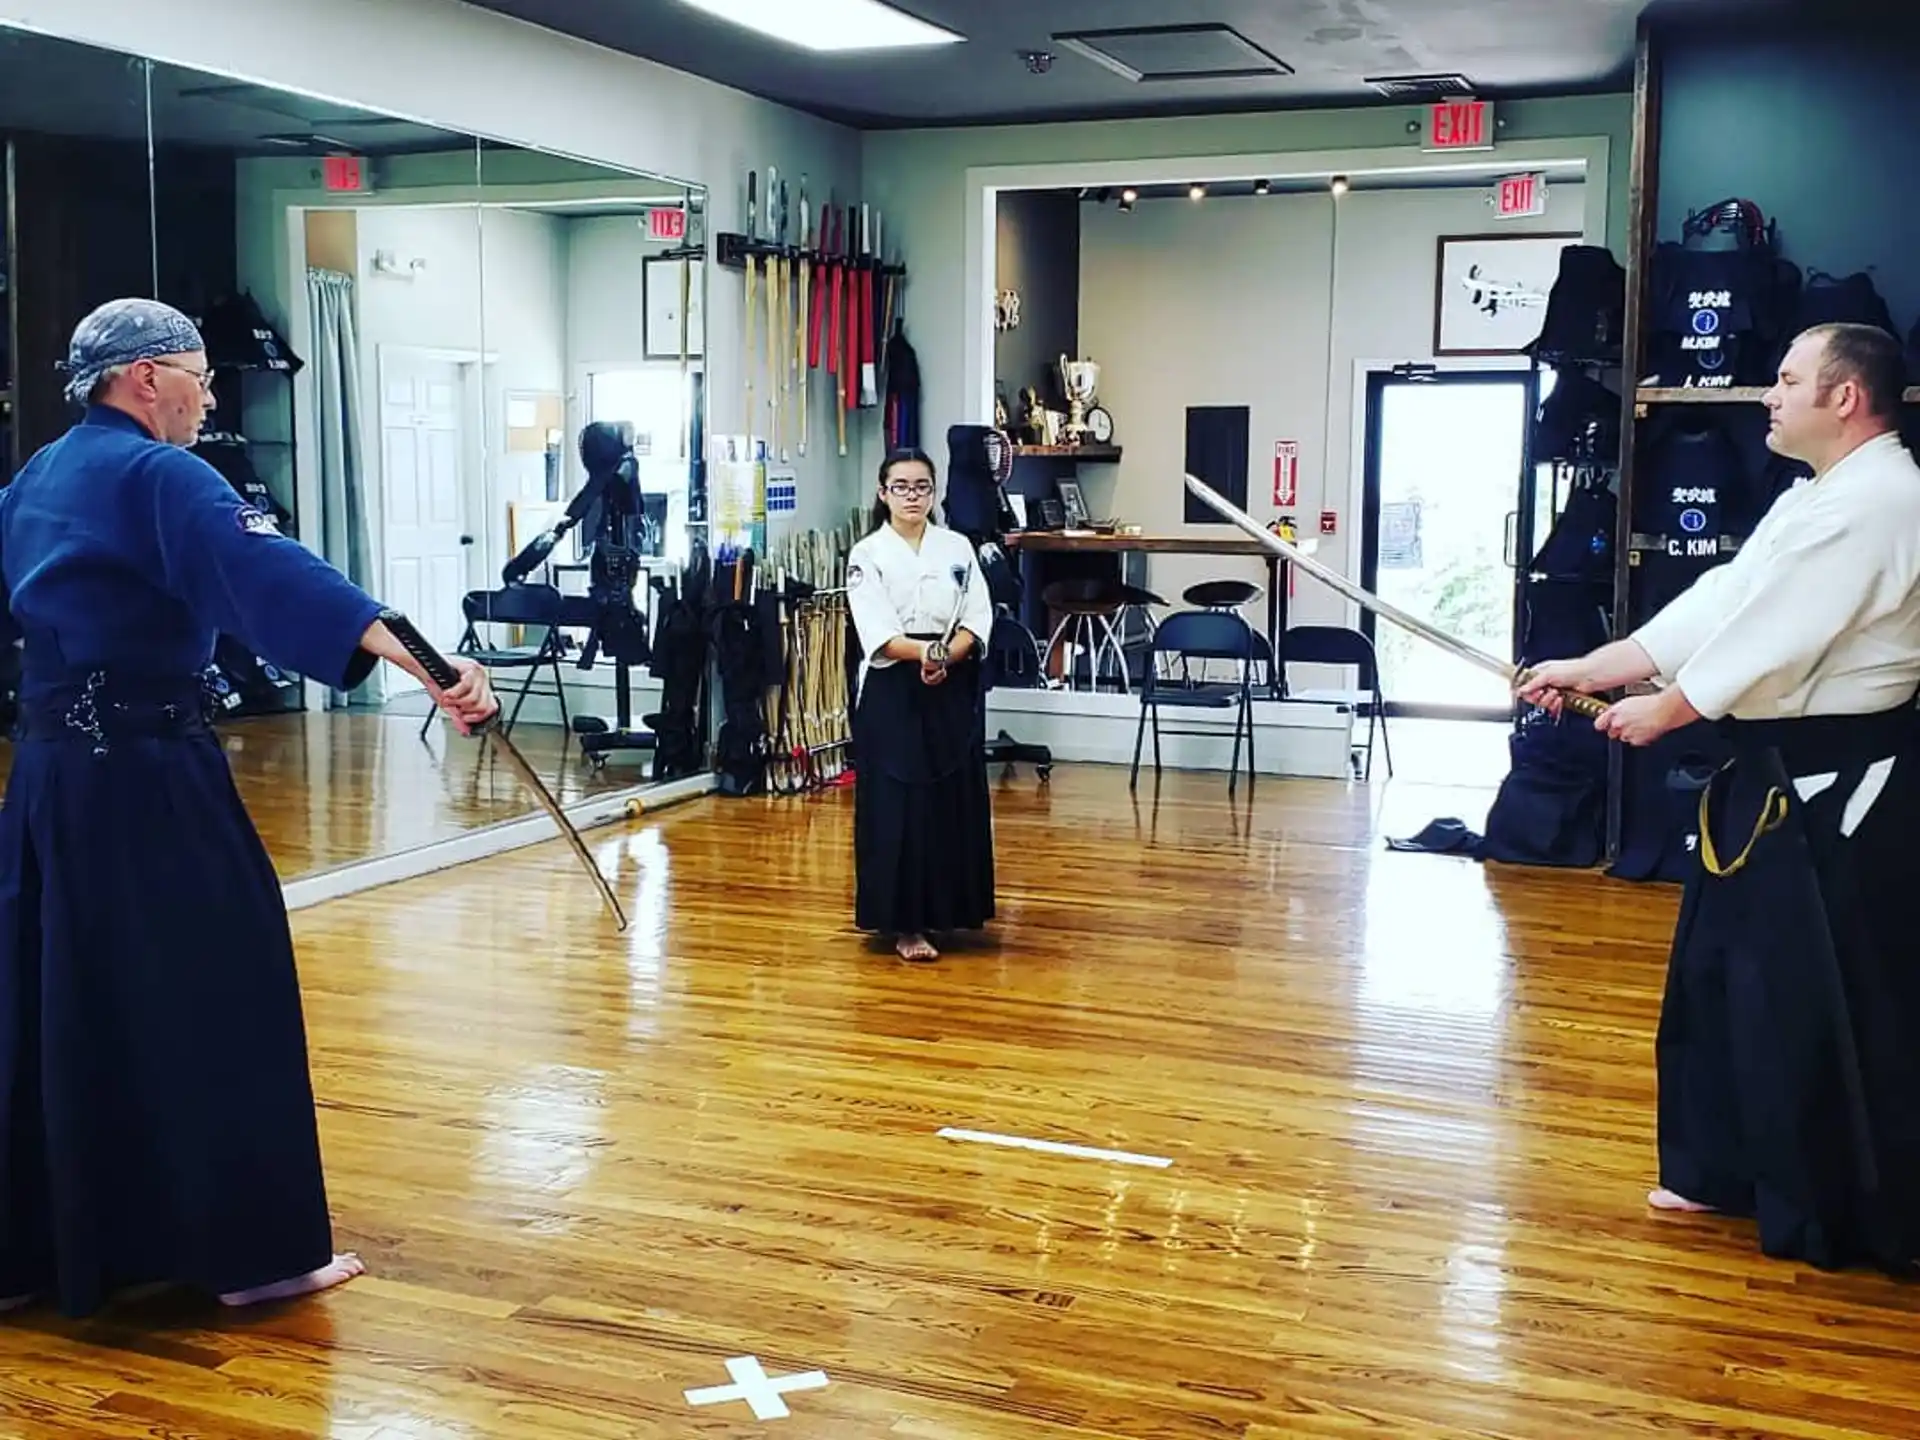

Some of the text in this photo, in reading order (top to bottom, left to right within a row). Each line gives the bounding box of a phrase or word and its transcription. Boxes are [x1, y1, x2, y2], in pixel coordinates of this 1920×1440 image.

[1432, 103, 1484, 146] EXIT
[1502, 179, 1535, 212] EXIT
[1668, 538, 1717, 556] C. KIM
